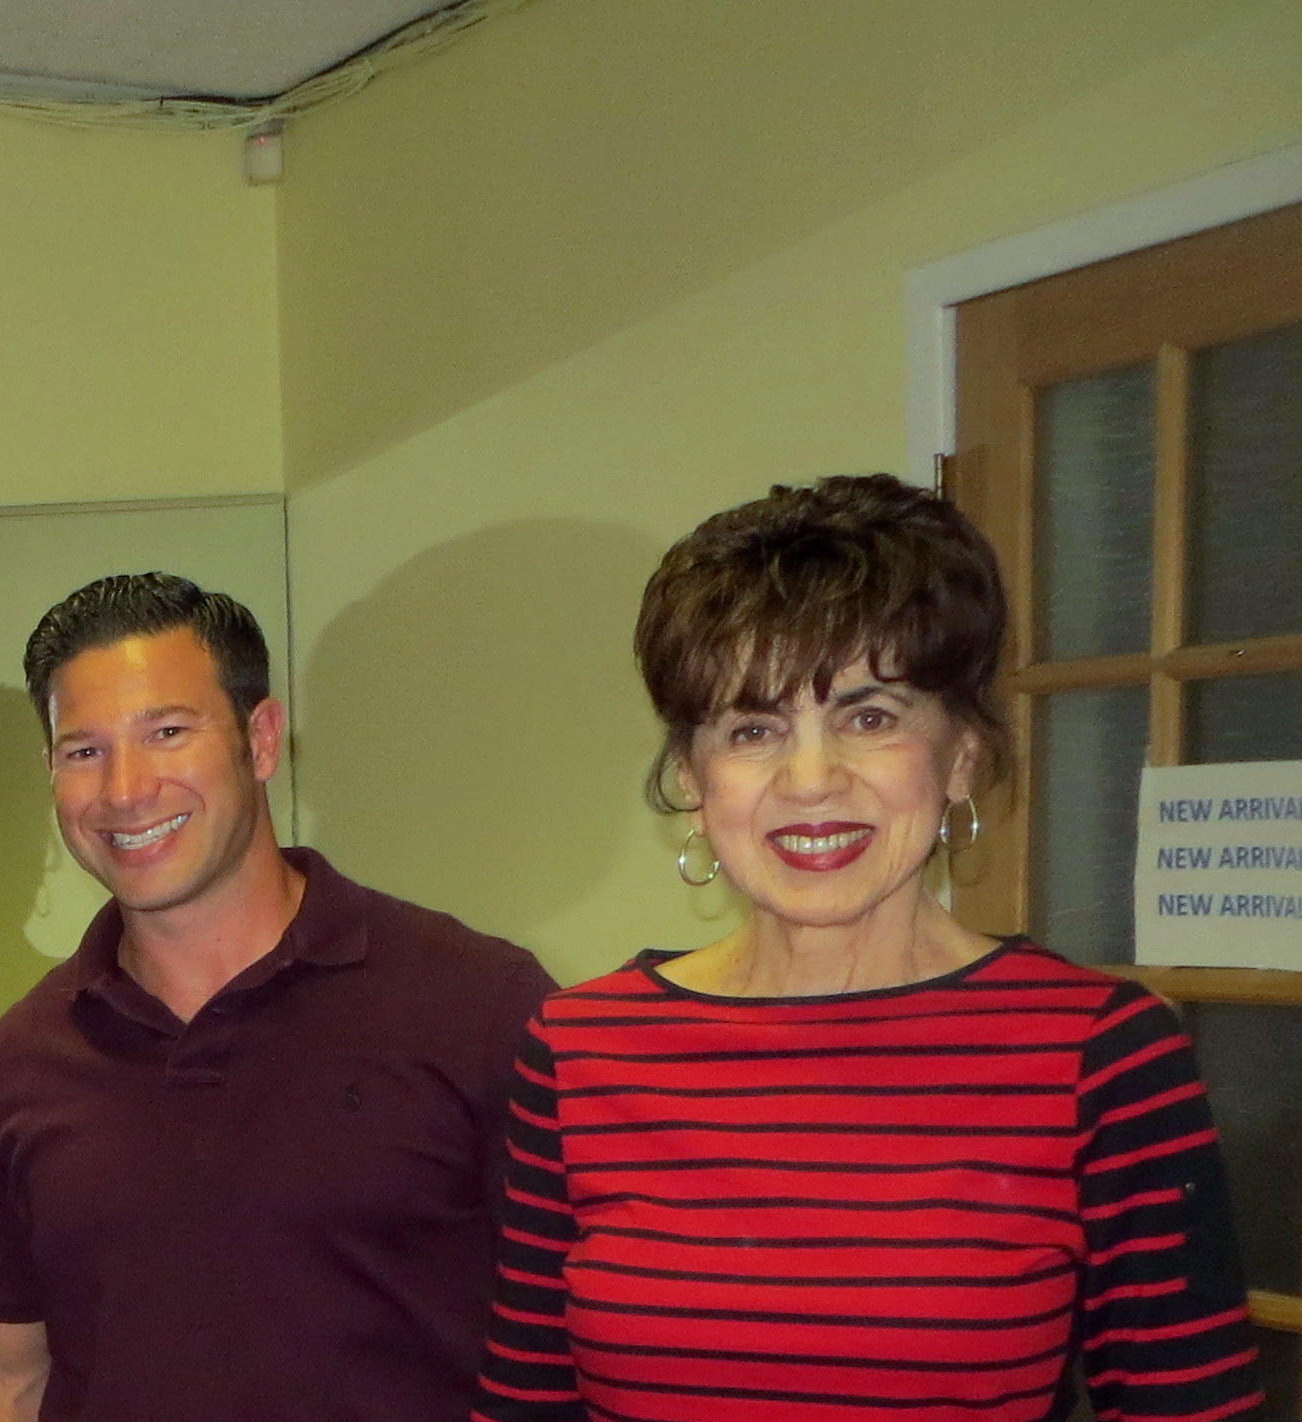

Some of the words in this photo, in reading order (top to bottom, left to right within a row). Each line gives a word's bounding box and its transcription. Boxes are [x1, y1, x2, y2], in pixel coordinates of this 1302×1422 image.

[1159, 799, 1213, 822] NEW
[1157, 847, 1212, 869] NEW
[1159, 894, 1214, 916] NEW
